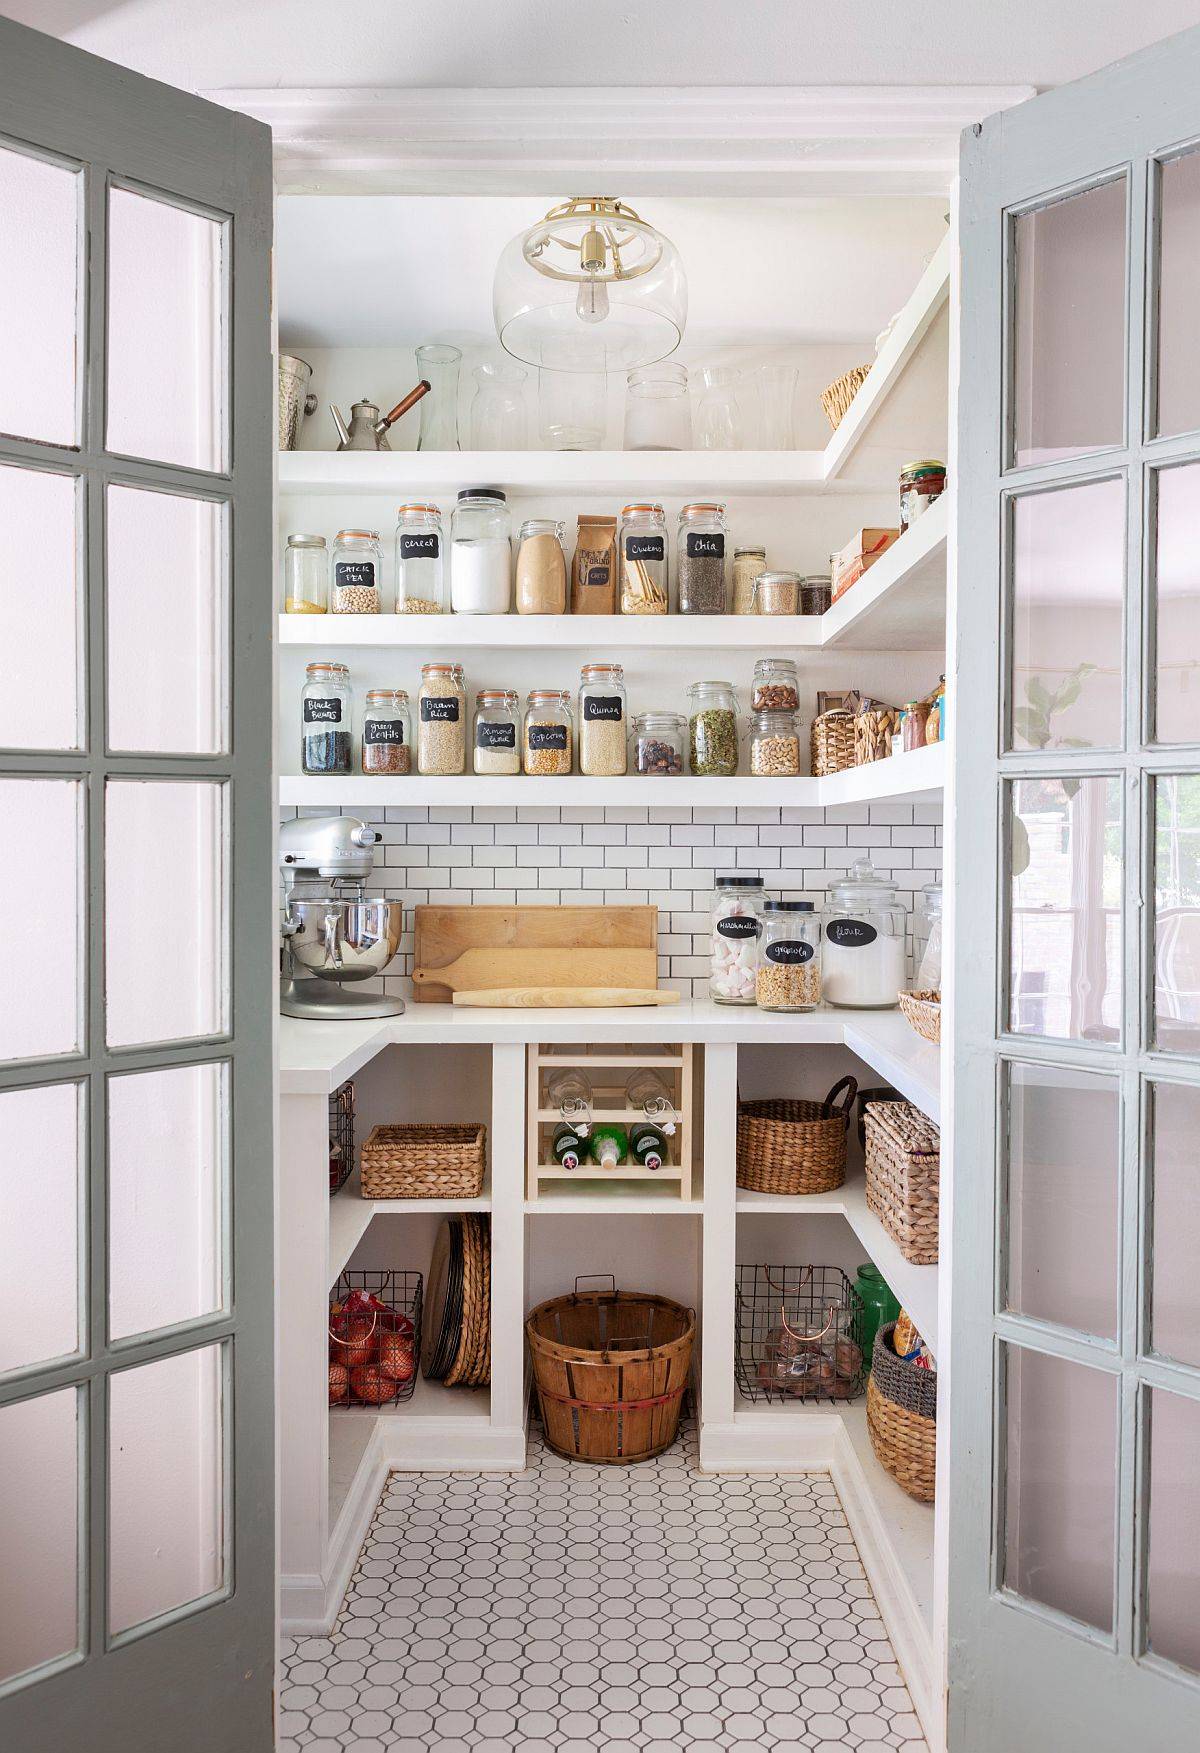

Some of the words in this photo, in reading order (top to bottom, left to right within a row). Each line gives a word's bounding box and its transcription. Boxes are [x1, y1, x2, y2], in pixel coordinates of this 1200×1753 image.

[404, 538, 434, 549] cereal
[694, 539, 719, 551] Chia
[589, 703, 620, 715] Quinoa
